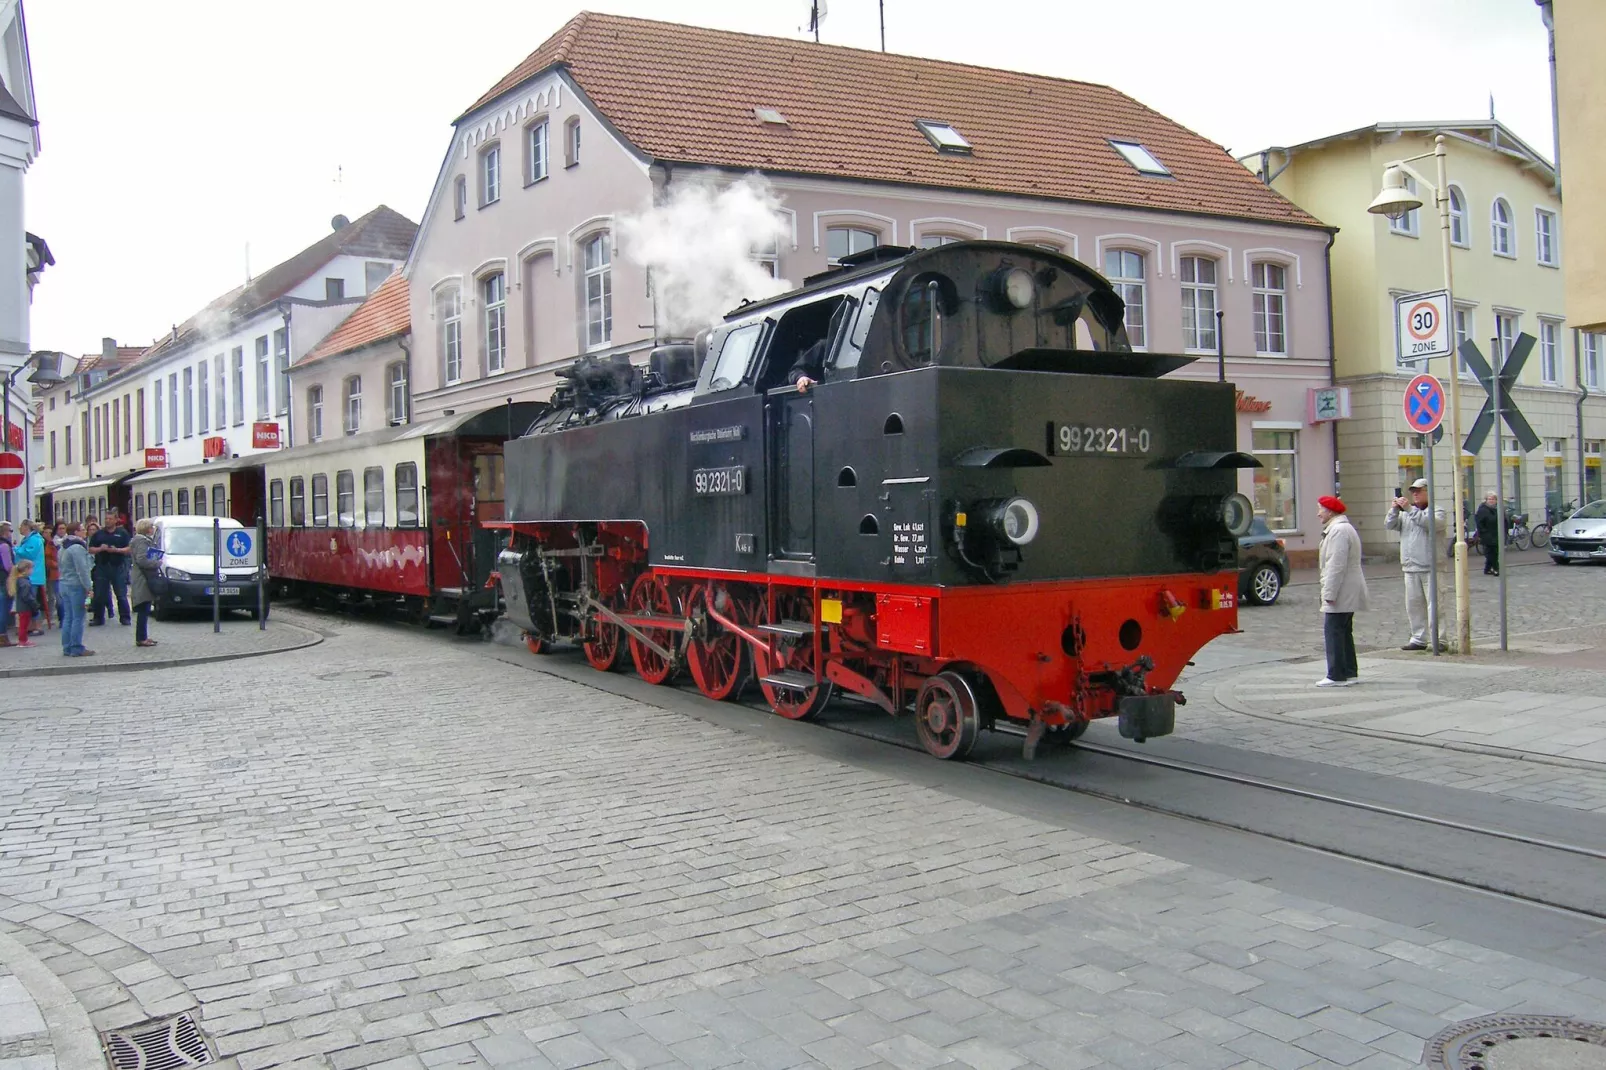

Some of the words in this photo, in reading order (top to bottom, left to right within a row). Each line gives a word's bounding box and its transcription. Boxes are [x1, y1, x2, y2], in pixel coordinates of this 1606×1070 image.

[1414, 312, 1433, 330] 30
[1412, 341, 1437, 353] ZONE
[256, 431, 278, 440] NKD
[1060, 426, 1081, 451] 99
[1084, 427, 1150, 453] 2321-0
[203, 437, 222, 458] NKD
[695, 473, 708, 493] 99
[709, 469, 743, 492] 2321-0
[229, 557, 249, 566] ZONE
